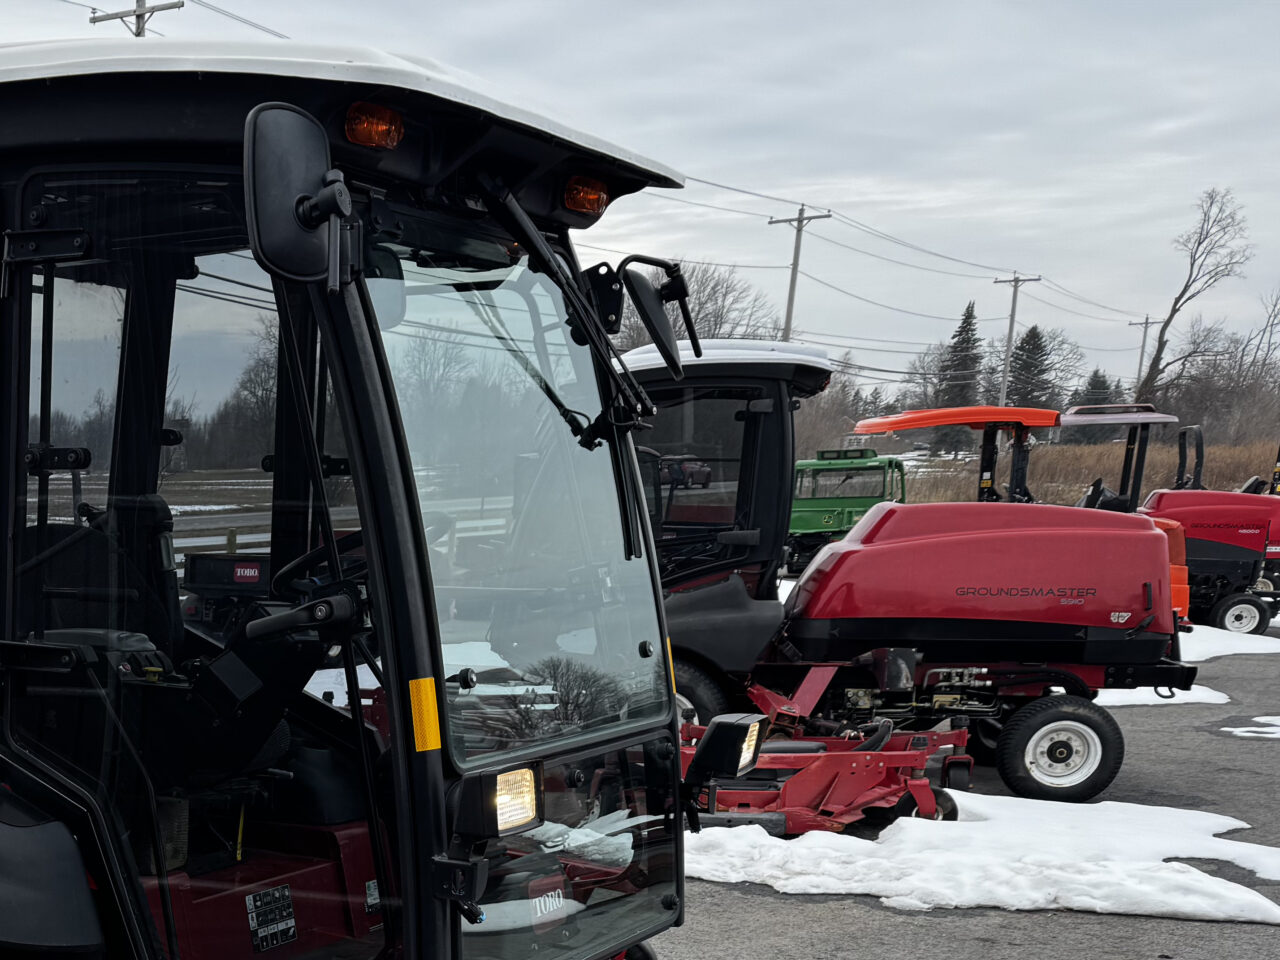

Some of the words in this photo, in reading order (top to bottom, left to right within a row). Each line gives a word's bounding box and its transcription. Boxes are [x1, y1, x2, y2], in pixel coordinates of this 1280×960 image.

[236, 568, 259, 577] TORO
[955, 587, 1097, 597] GROUNDSMASTER
[532, 888, 563, 917] TORO
